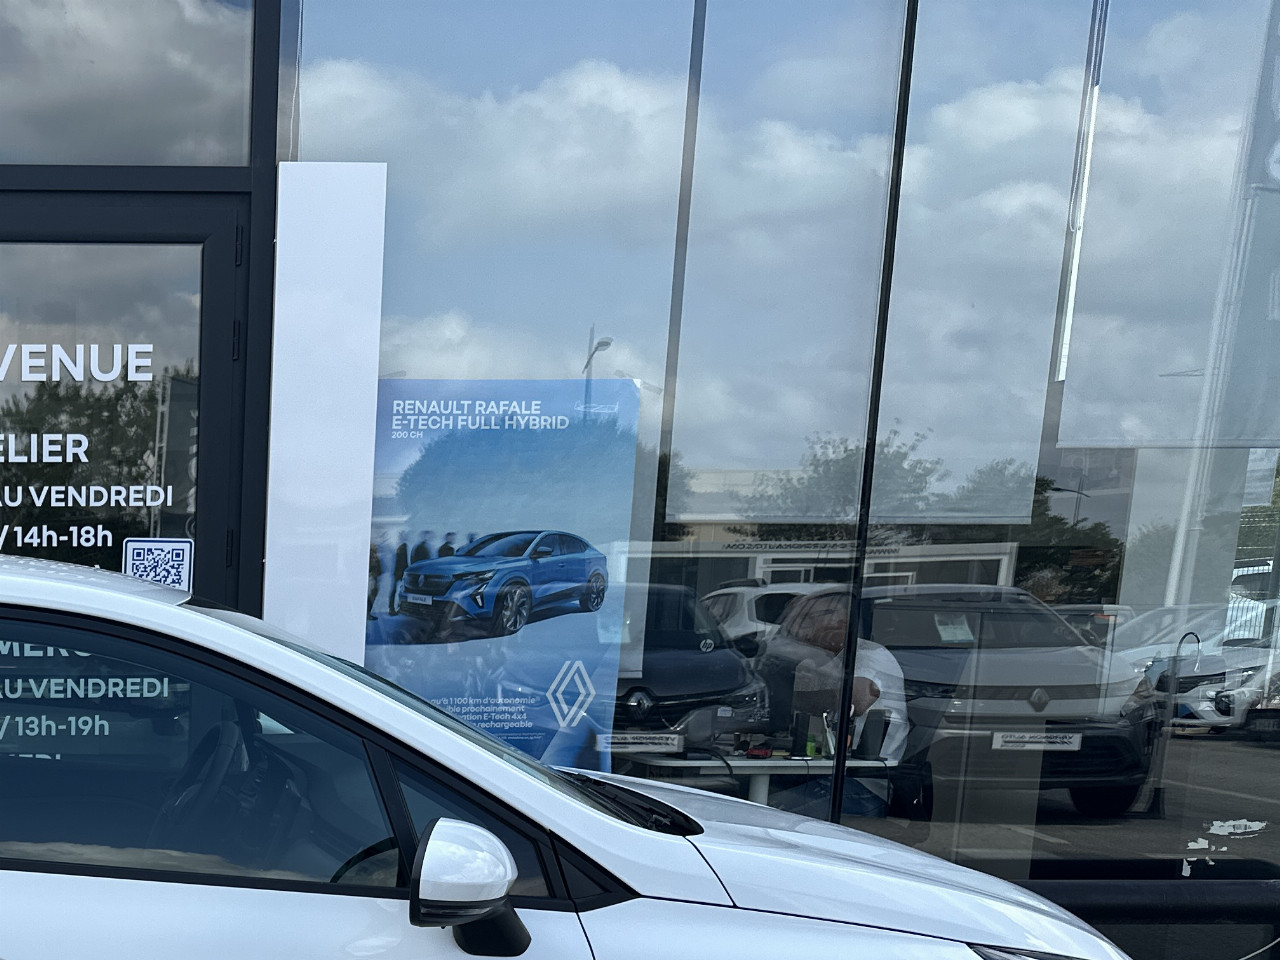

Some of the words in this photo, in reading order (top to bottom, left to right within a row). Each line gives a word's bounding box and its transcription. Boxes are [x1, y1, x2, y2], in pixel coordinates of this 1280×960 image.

[392, 400, 471, 414] RENAULT
[475, 400, 541, 414] RAFALE
[392, 415, 453, 430] E-TECH
[457, 415, 500, 430] FULL
[505, 415, 569, 430] HYBRID
[392, 431, 408, 439] 200
[410, 431, 423, 439] CH
[28, 485, 173, 507] VENDREDI
[14, 525, 113, 548] 14h-18h
[702, 640, 713, 651] hp
[29, 678, 169, 699] VENDREDI
[468, 697, 482, 705] km
[461, 705, 525, 715] prochainement
[483, 713, 511, 721] E-Tech
[15, 715, 110, 737] 13h-19h
[478, 720, 533, 730] rechargeable
